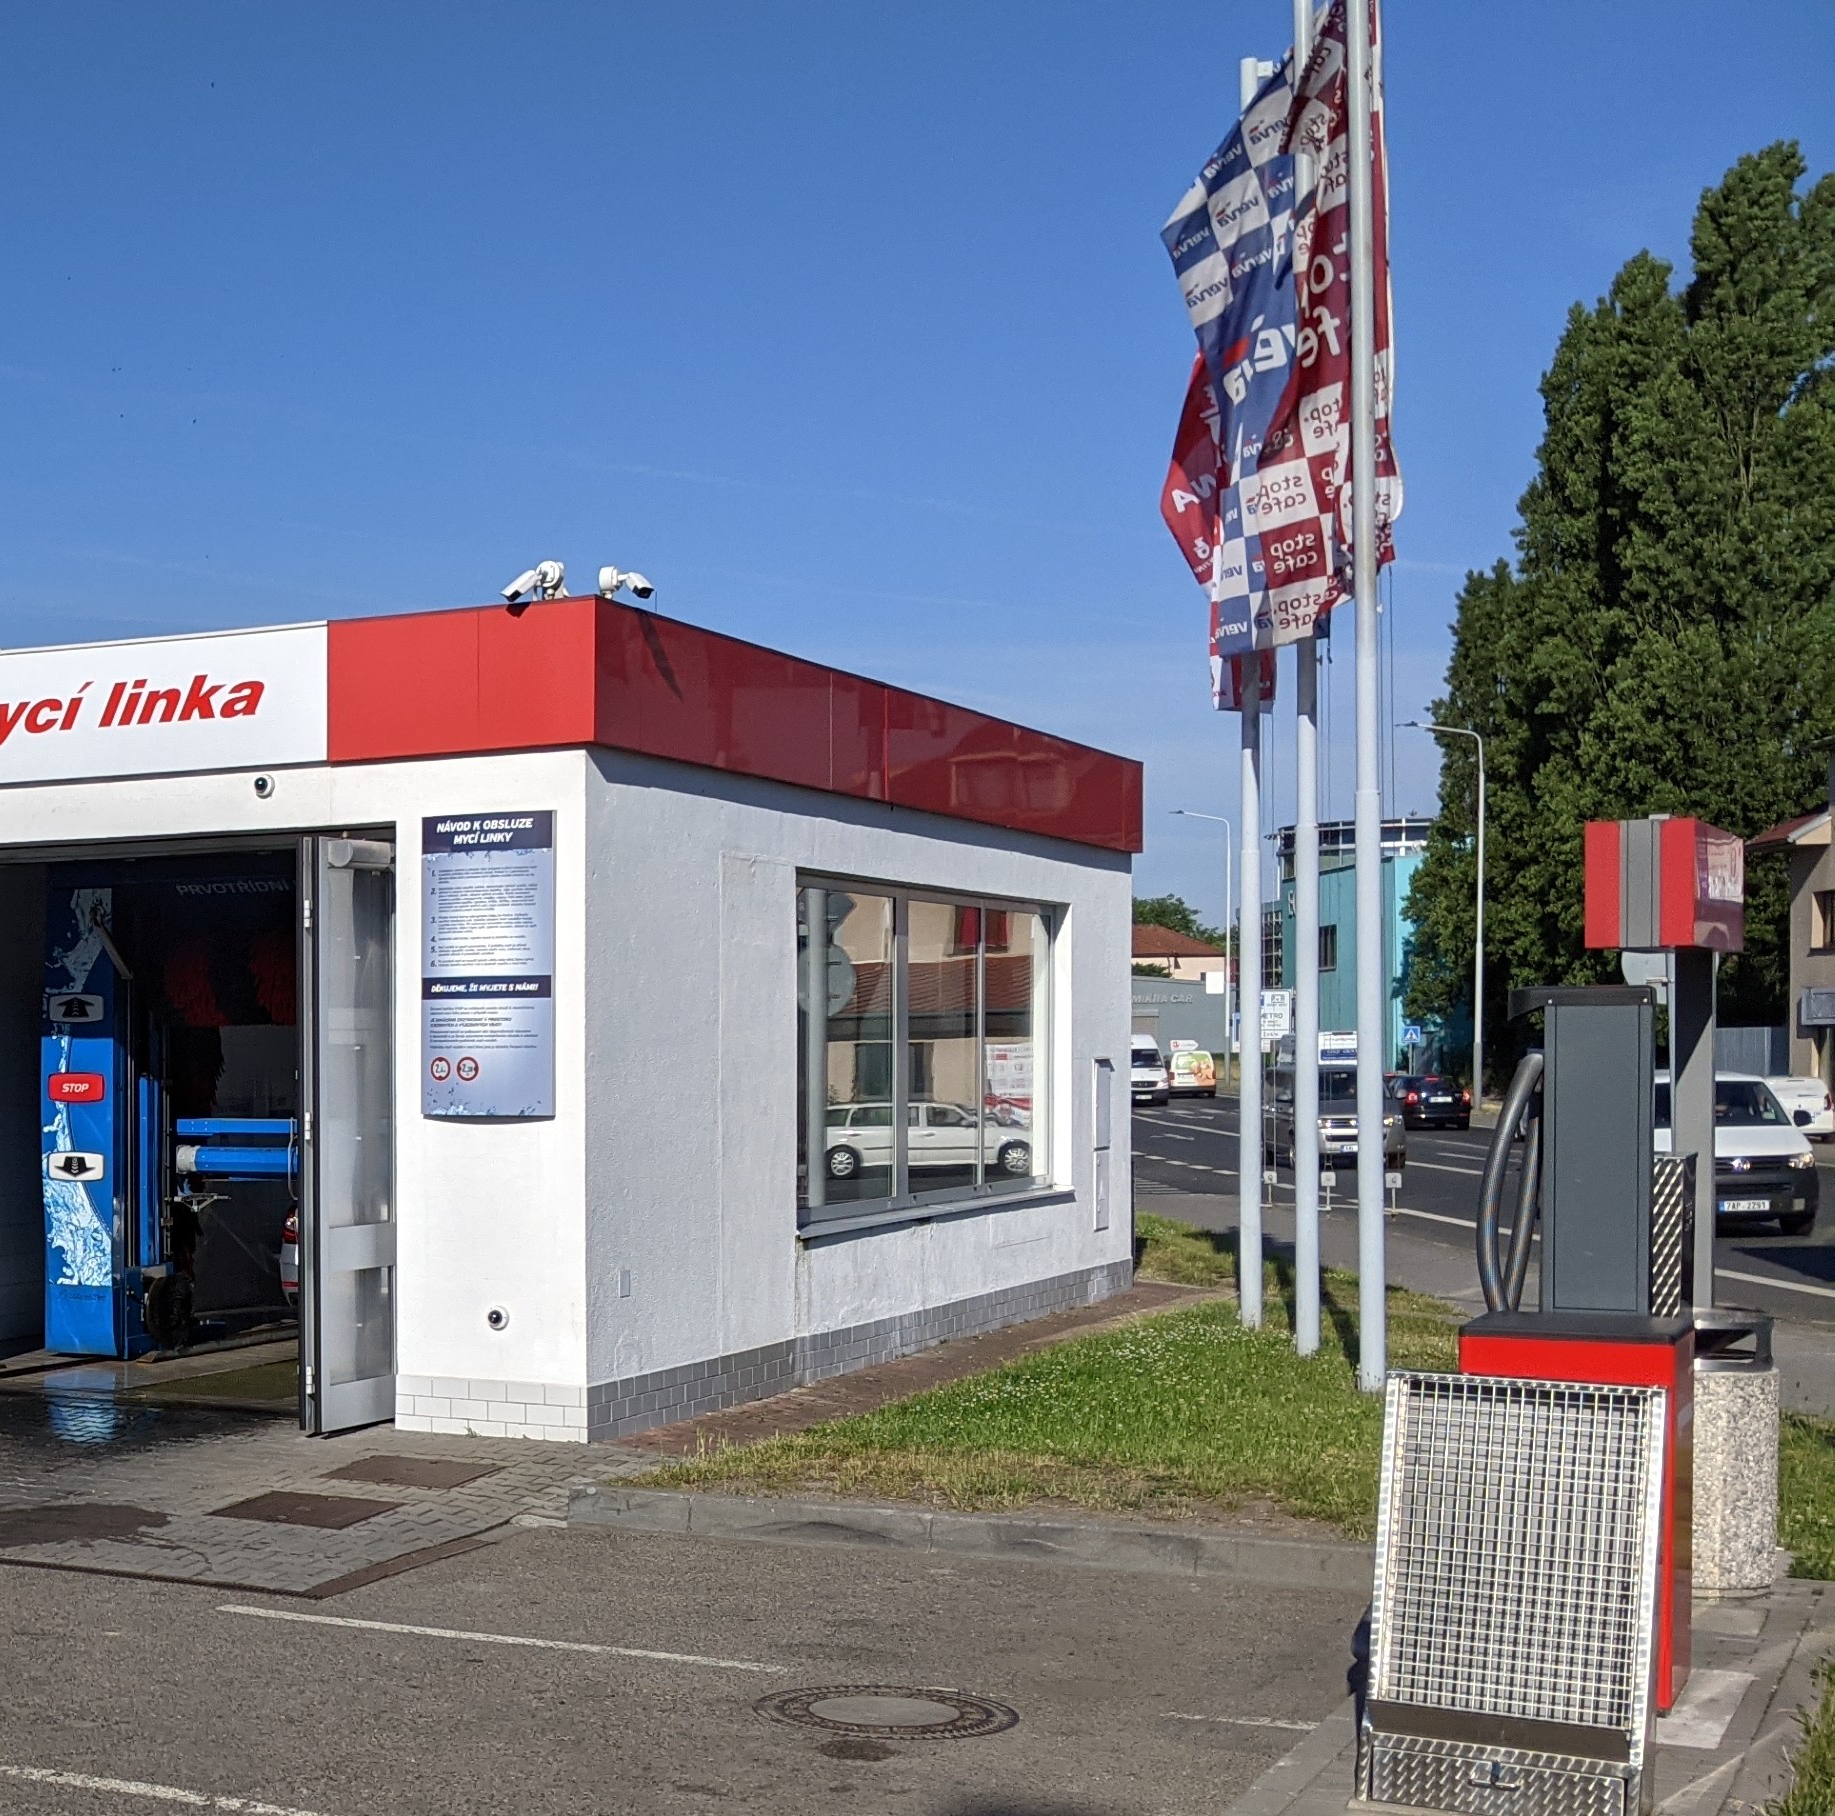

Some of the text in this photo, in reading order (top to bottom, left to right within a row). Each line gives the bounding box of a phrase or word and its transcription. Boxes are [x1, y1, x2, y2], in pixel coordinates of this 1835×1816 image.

[98, 674, 266, 729] linka
[437, 818, 534, 833] NÁVOD K OBSLUZE
[453, 831, 513, 845] MYCÍ LINKY
[61, 1082, 90, 1094] STOP
